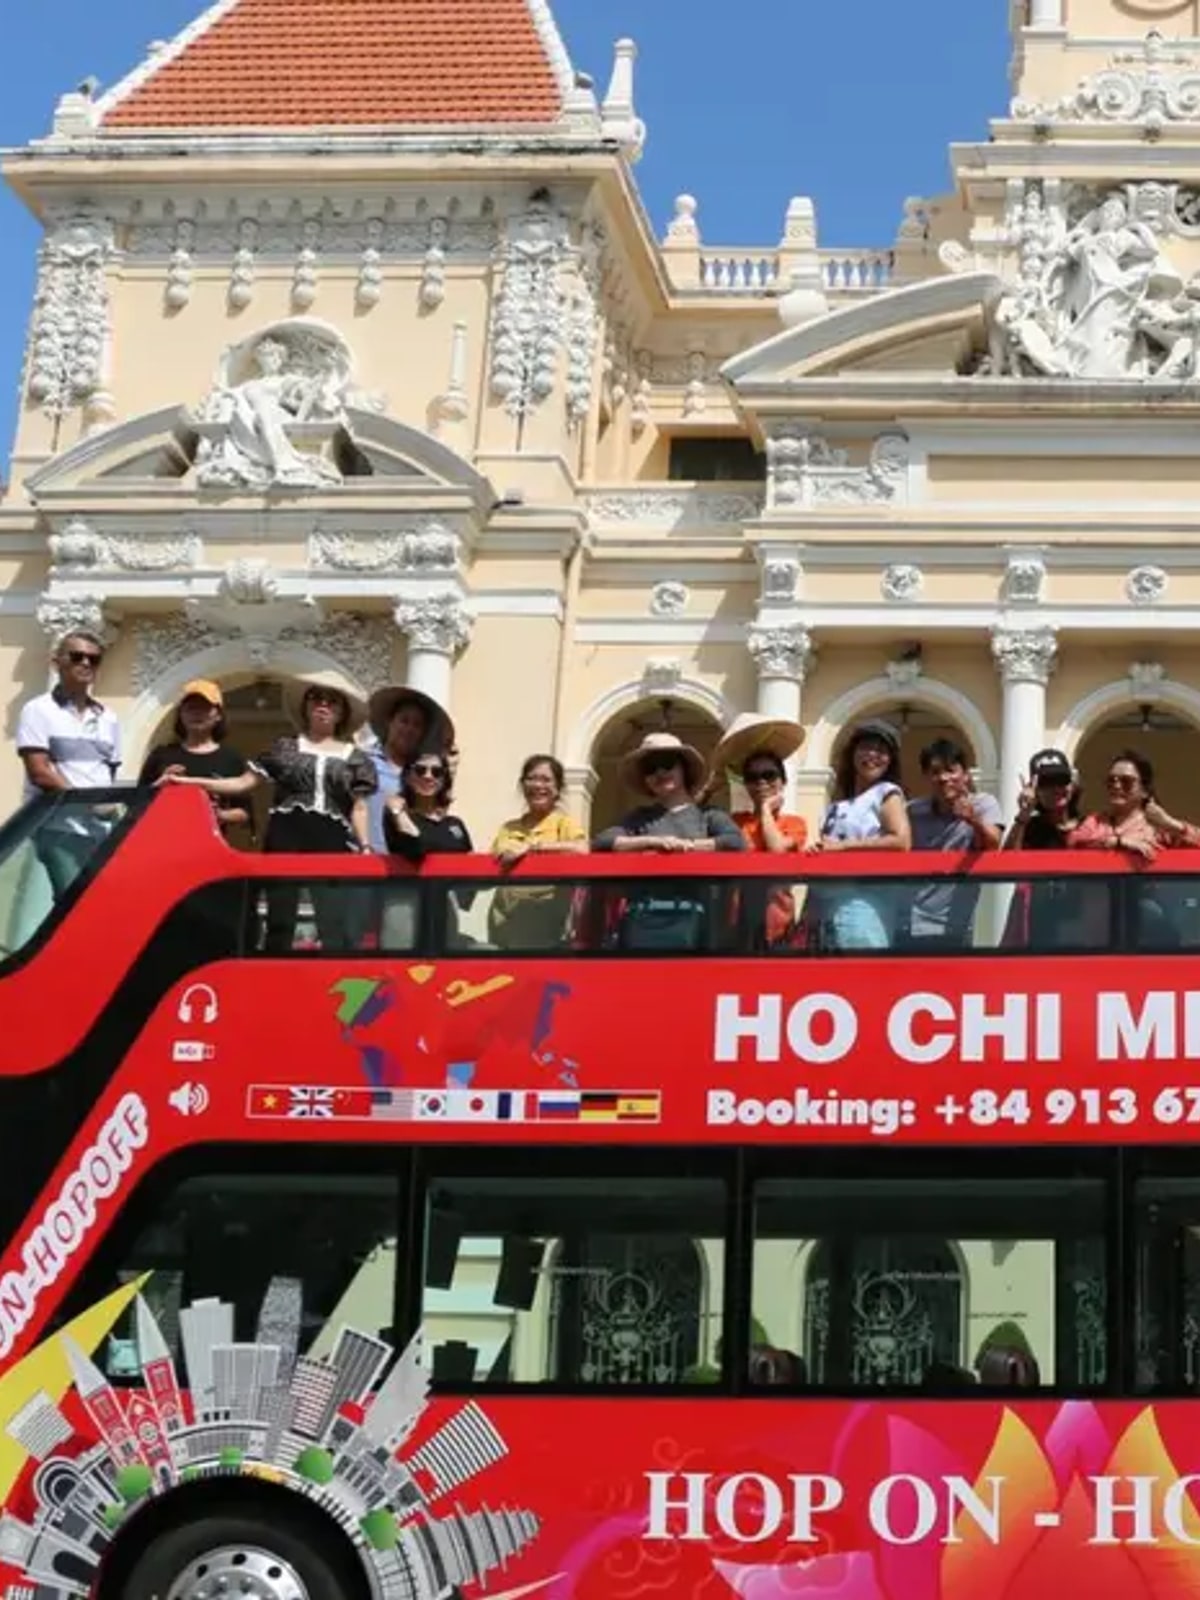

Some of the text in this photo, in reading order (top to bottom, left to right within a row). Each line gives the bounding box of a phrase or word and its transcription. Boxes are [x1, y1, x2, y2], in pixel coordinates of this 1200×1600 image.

[714, 992, 858, 1063] HO
[887, 992, 1061, 1064] CHI
[706, 1089, 915, 1135] Booking:
[935, 1089, 1031, 1125] +84
[1045, 1089, 1138, 1124] 913
[0, 1098, 144, 1350] N-HOPOFF
[643, 1472, 843, 1543] HOP
[869, 1475, 1005, 1544] ON
